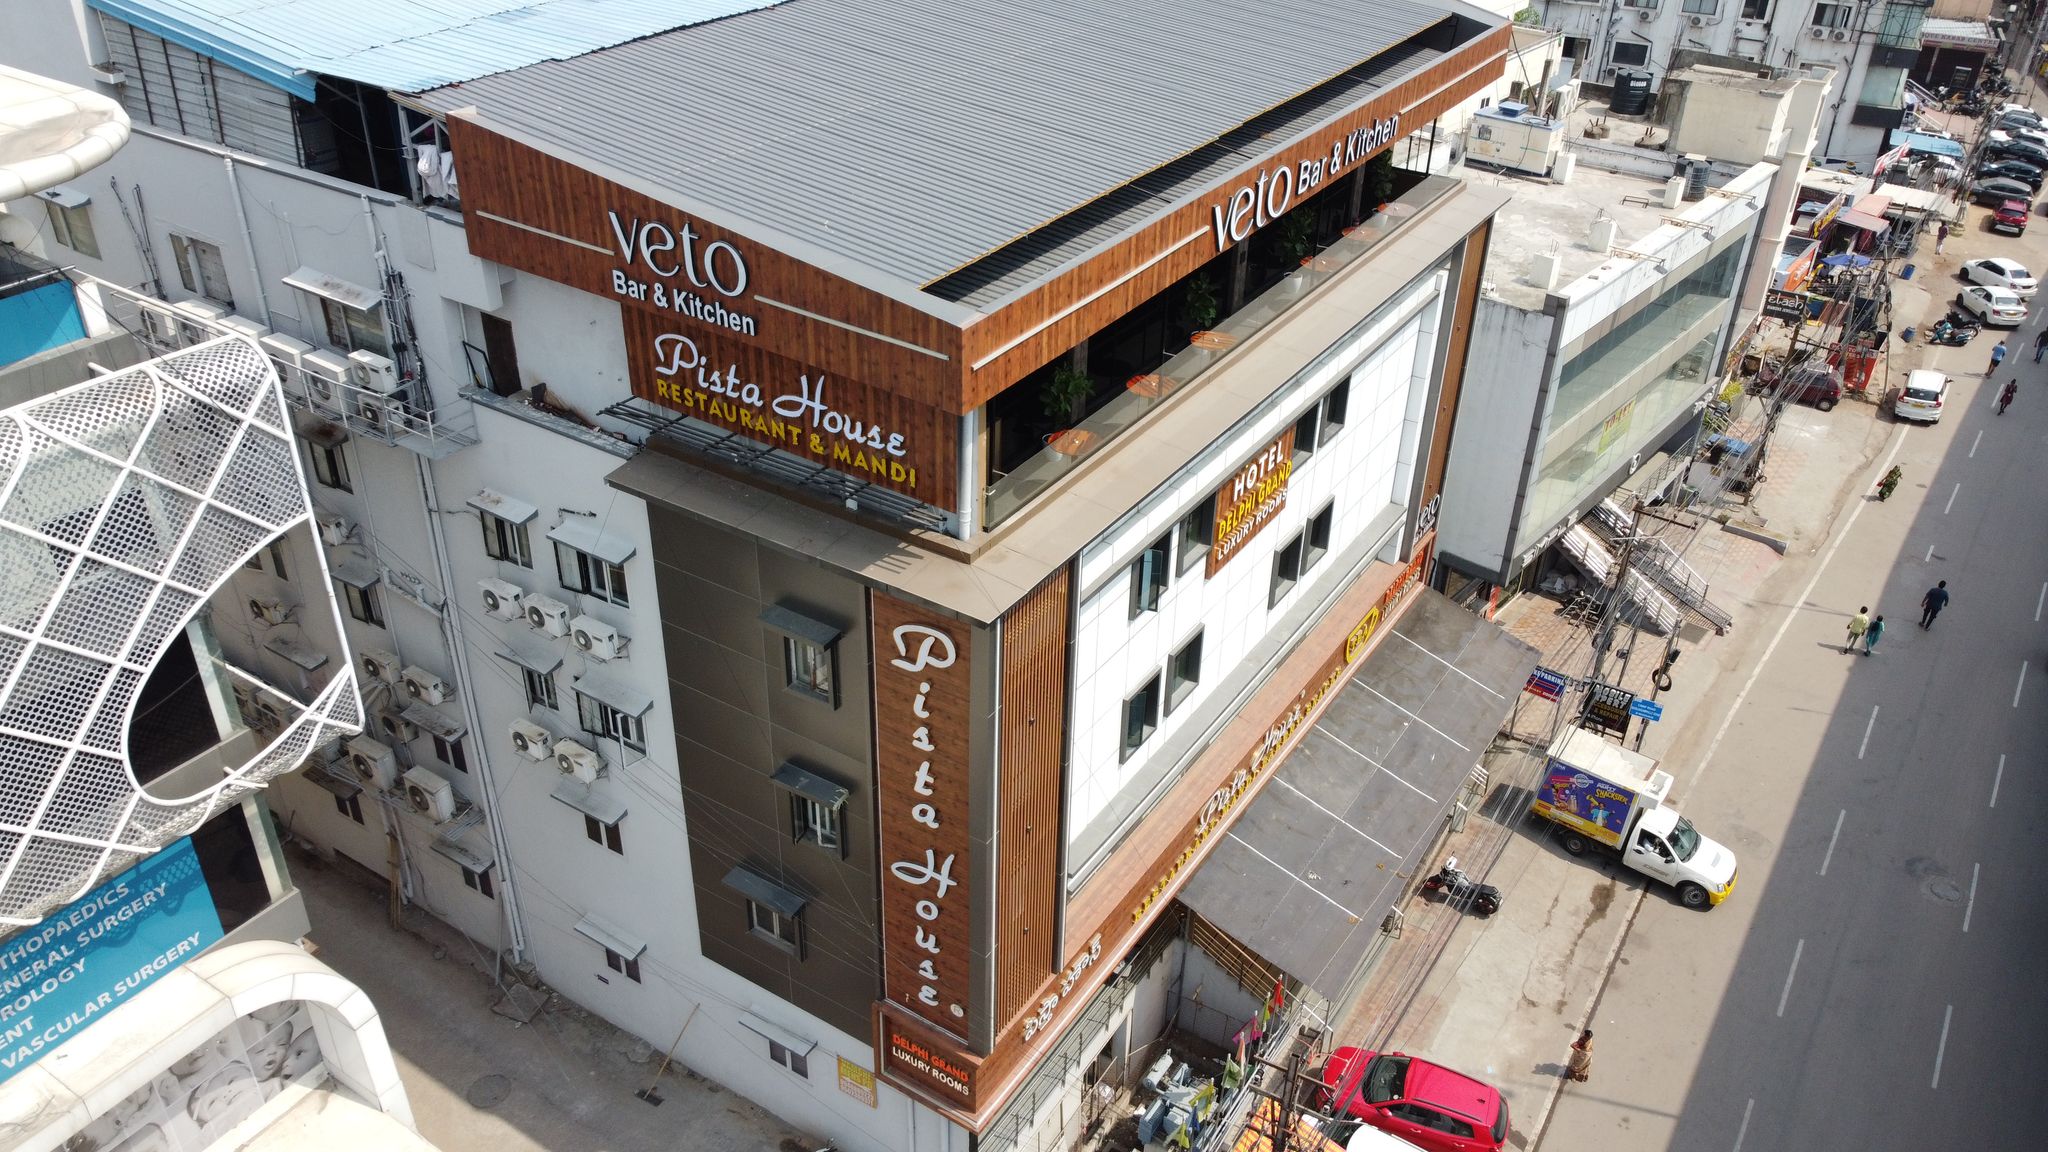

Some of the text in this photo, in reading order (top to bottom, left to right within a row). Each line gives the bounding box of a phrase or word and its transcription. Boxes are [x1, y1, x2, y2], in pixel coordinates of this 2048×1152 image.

[1297, 155, 1328, 196] Bar
[1329, 140, 1342, 175] &
[1344, 114, 1400, 166] Kitchen
[612, 269, 756, 337] Bar & Kitchen
[654, 332, 907, 457] Pista House
[655, 377, 917, 488] RESTAURANT & MANDI
[1218, 460, 1293, 540] DELPHI GRAND
[1233, 441, 1284, 502] HOTEL
[1217, 489, 1288, 561] LUXURY ROOMS
[890, 623, 958, 1008] Pista House
[76, 881, 167, 947] SURGERY
[0, 956, 86, 1022] ROLOGY
[1, 930, 201, 1068] VASCULAR SURGERY
[892, 1033, 969, 1082] DELPHI GRAND
[892, 1046, 969, 1096] LUXURY ROOMS
